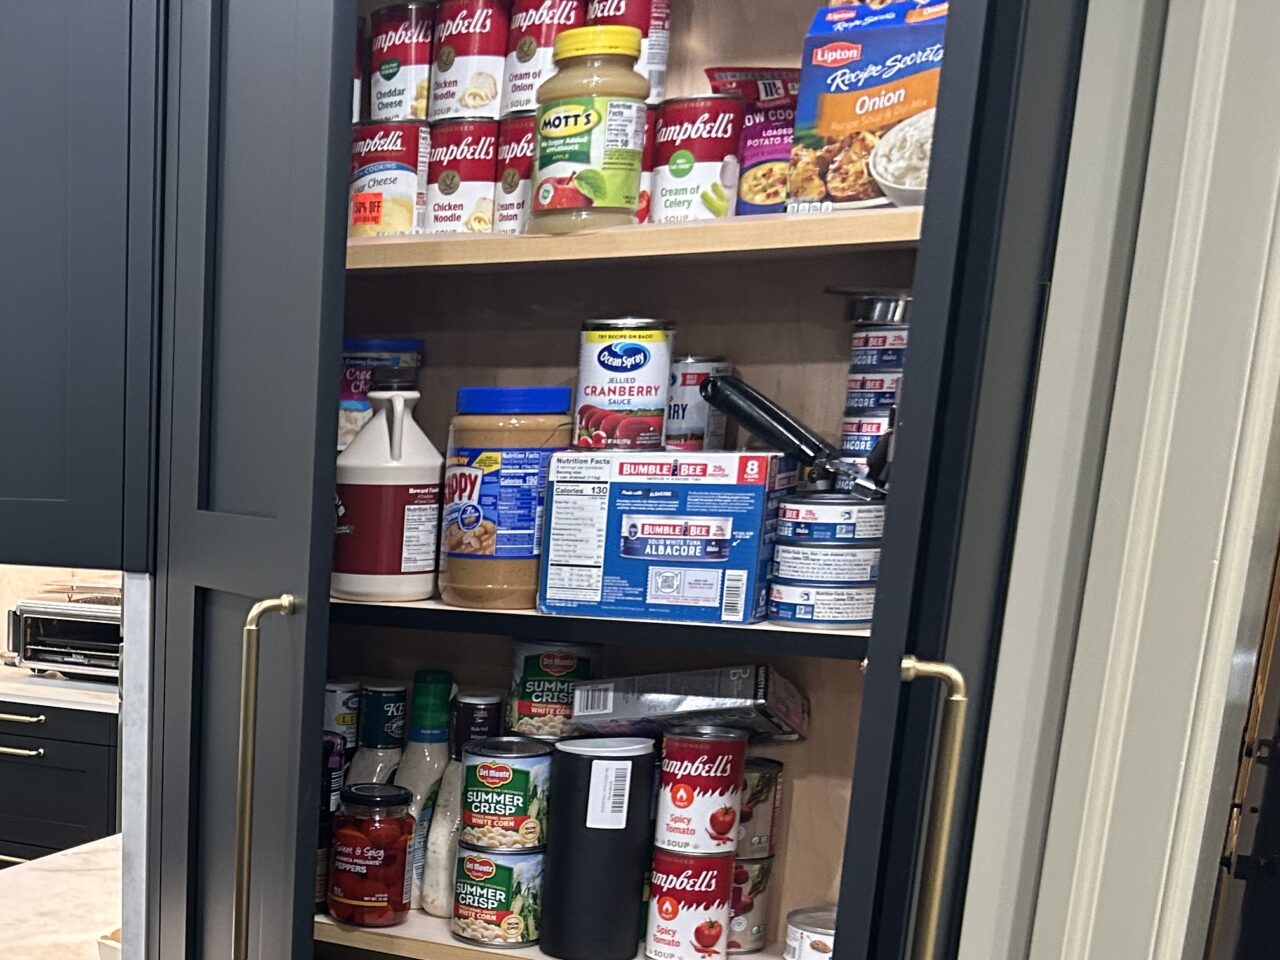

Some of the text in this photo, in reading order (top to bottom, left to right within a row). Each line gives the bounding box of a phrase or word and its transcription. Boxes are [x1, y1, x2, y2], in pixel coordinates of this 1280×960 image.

[817, 48, 858, 63] Lipton
[826, 44, 944, 92] Recipe Secrets
[509, 69, 542, 83] Cream of
[376, 87, 407, 101] Cheddar
[511, 83, 534, 94] Onion
[377, 99, 404, 112] Cheese
[855, 87, 906, 115] Onion
[541, 112, 593, 132] MOTT'S
[762, 128, 793, 138] LOADED
[746, 136, 781, 147] POTATO
[364, 163, 397, 174] COOKING
[367, 176, 398, 189] Cheese
[660, 184, 700, 198] Cream of
[369, 200, 382, 214] OFF
[433, 201, 464, 212] Chicken
[663, 198, 693, 210] Celery
[433, 213, 462, 224] Noodle
[869, 336, 884, 346] BEE
[600, 351, 644, 368] Ocean Spray
[607, 377, 636, 385] JELLIED
[866, 380, 881, 389] BEE
[583, 385, 660, 397] CRANBERRY
[862, 423, 880, 433] BEE
[622, 463, 705, 475] BUMBLE BEE
[746, 460, 759, 474] 8
[500, 477, 523, 485] Calories
[591, 486, 608, 495] 130
[643, 524, 708, 536] BUMBLE BEE
[644, 544, 702, 557] ALBACORE
[525, 680, 575, 693] SUMME
[531, 707, 555, 715] WHITE
[489, 768, 510, 778] Monte
[467, 790, 524, 807] SUMMER
[471, 801, 516, 816] CRISP
[471, 817, 515, 827] WHITE CORN
[669, 813, 692, 825] Spicy
[664, 823, 696, 836] Tomato
[666, 839, 690, 848] SOUP
[363, 846, 385, 861] Spicy
[335, 861, 367, 874] PEPPERS
[474, 862, 494, 873] Monte
[651, 869, 718, 892] ampbell's
[456, 882, 506, 903] SUMMER
[459, 893, 498, 910] CRISP
[459, 910, 497, 922] WHITE CORN
[655, 924, 677, 937] Spicy
[652, 934, 681, 948] Tomato
[653, 950, 675, 959] SOUP
